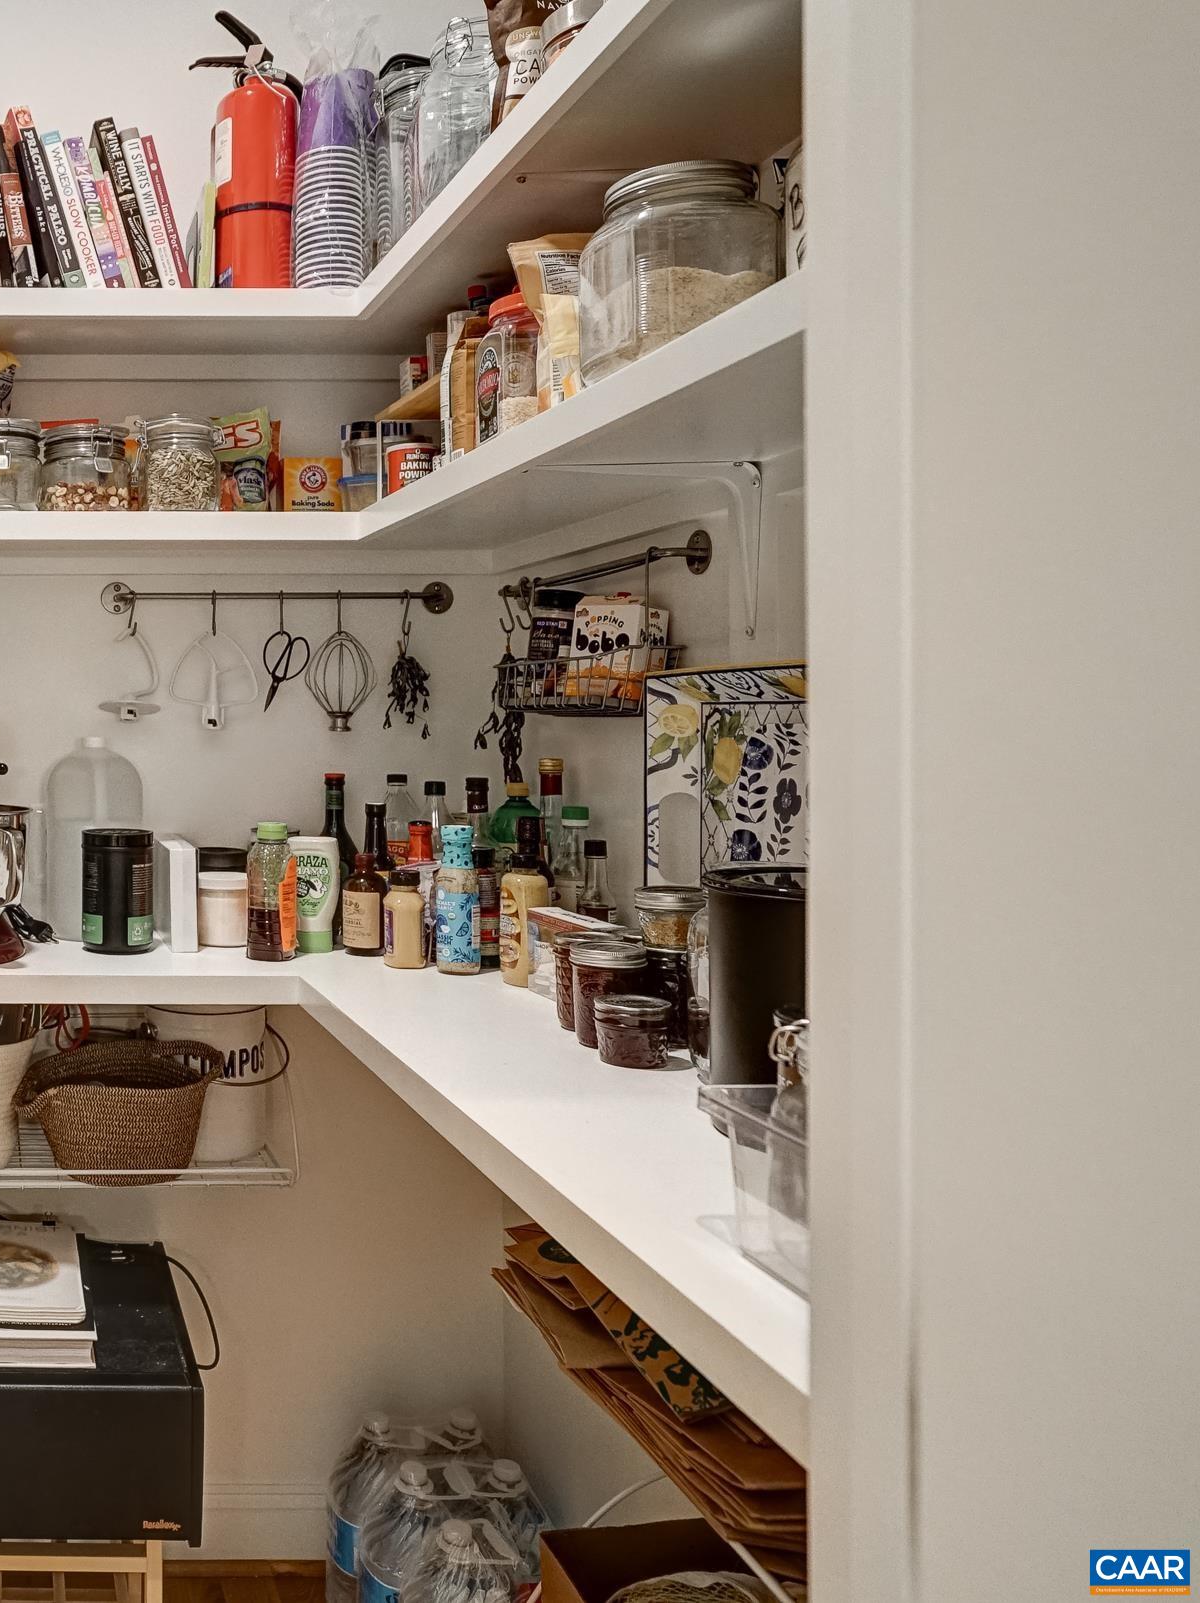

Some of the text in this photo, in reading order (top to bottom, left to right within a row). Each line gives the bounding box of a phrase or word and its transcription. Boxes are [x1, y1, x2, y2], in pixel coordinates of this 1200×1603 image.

[516, 58, 541, 75] CA
[22, 129, 54, 201] PRACTICAL
[47, 204, 68, 246] PALEO
[105, 129, 133, 193] WINE FOLLY
[7, 191, 26, 238] BITTERS
[75, 165, 106, 230] KOMBUCHA
[127, 141, 166, 246] IT STARTS WITH FOOD
[66, 199, 84, 229] SLOW
[77, 230, 98, 276] COOKER
[161, 203, 176, 233] Instant
[169, 233, 180, 249] Pot
